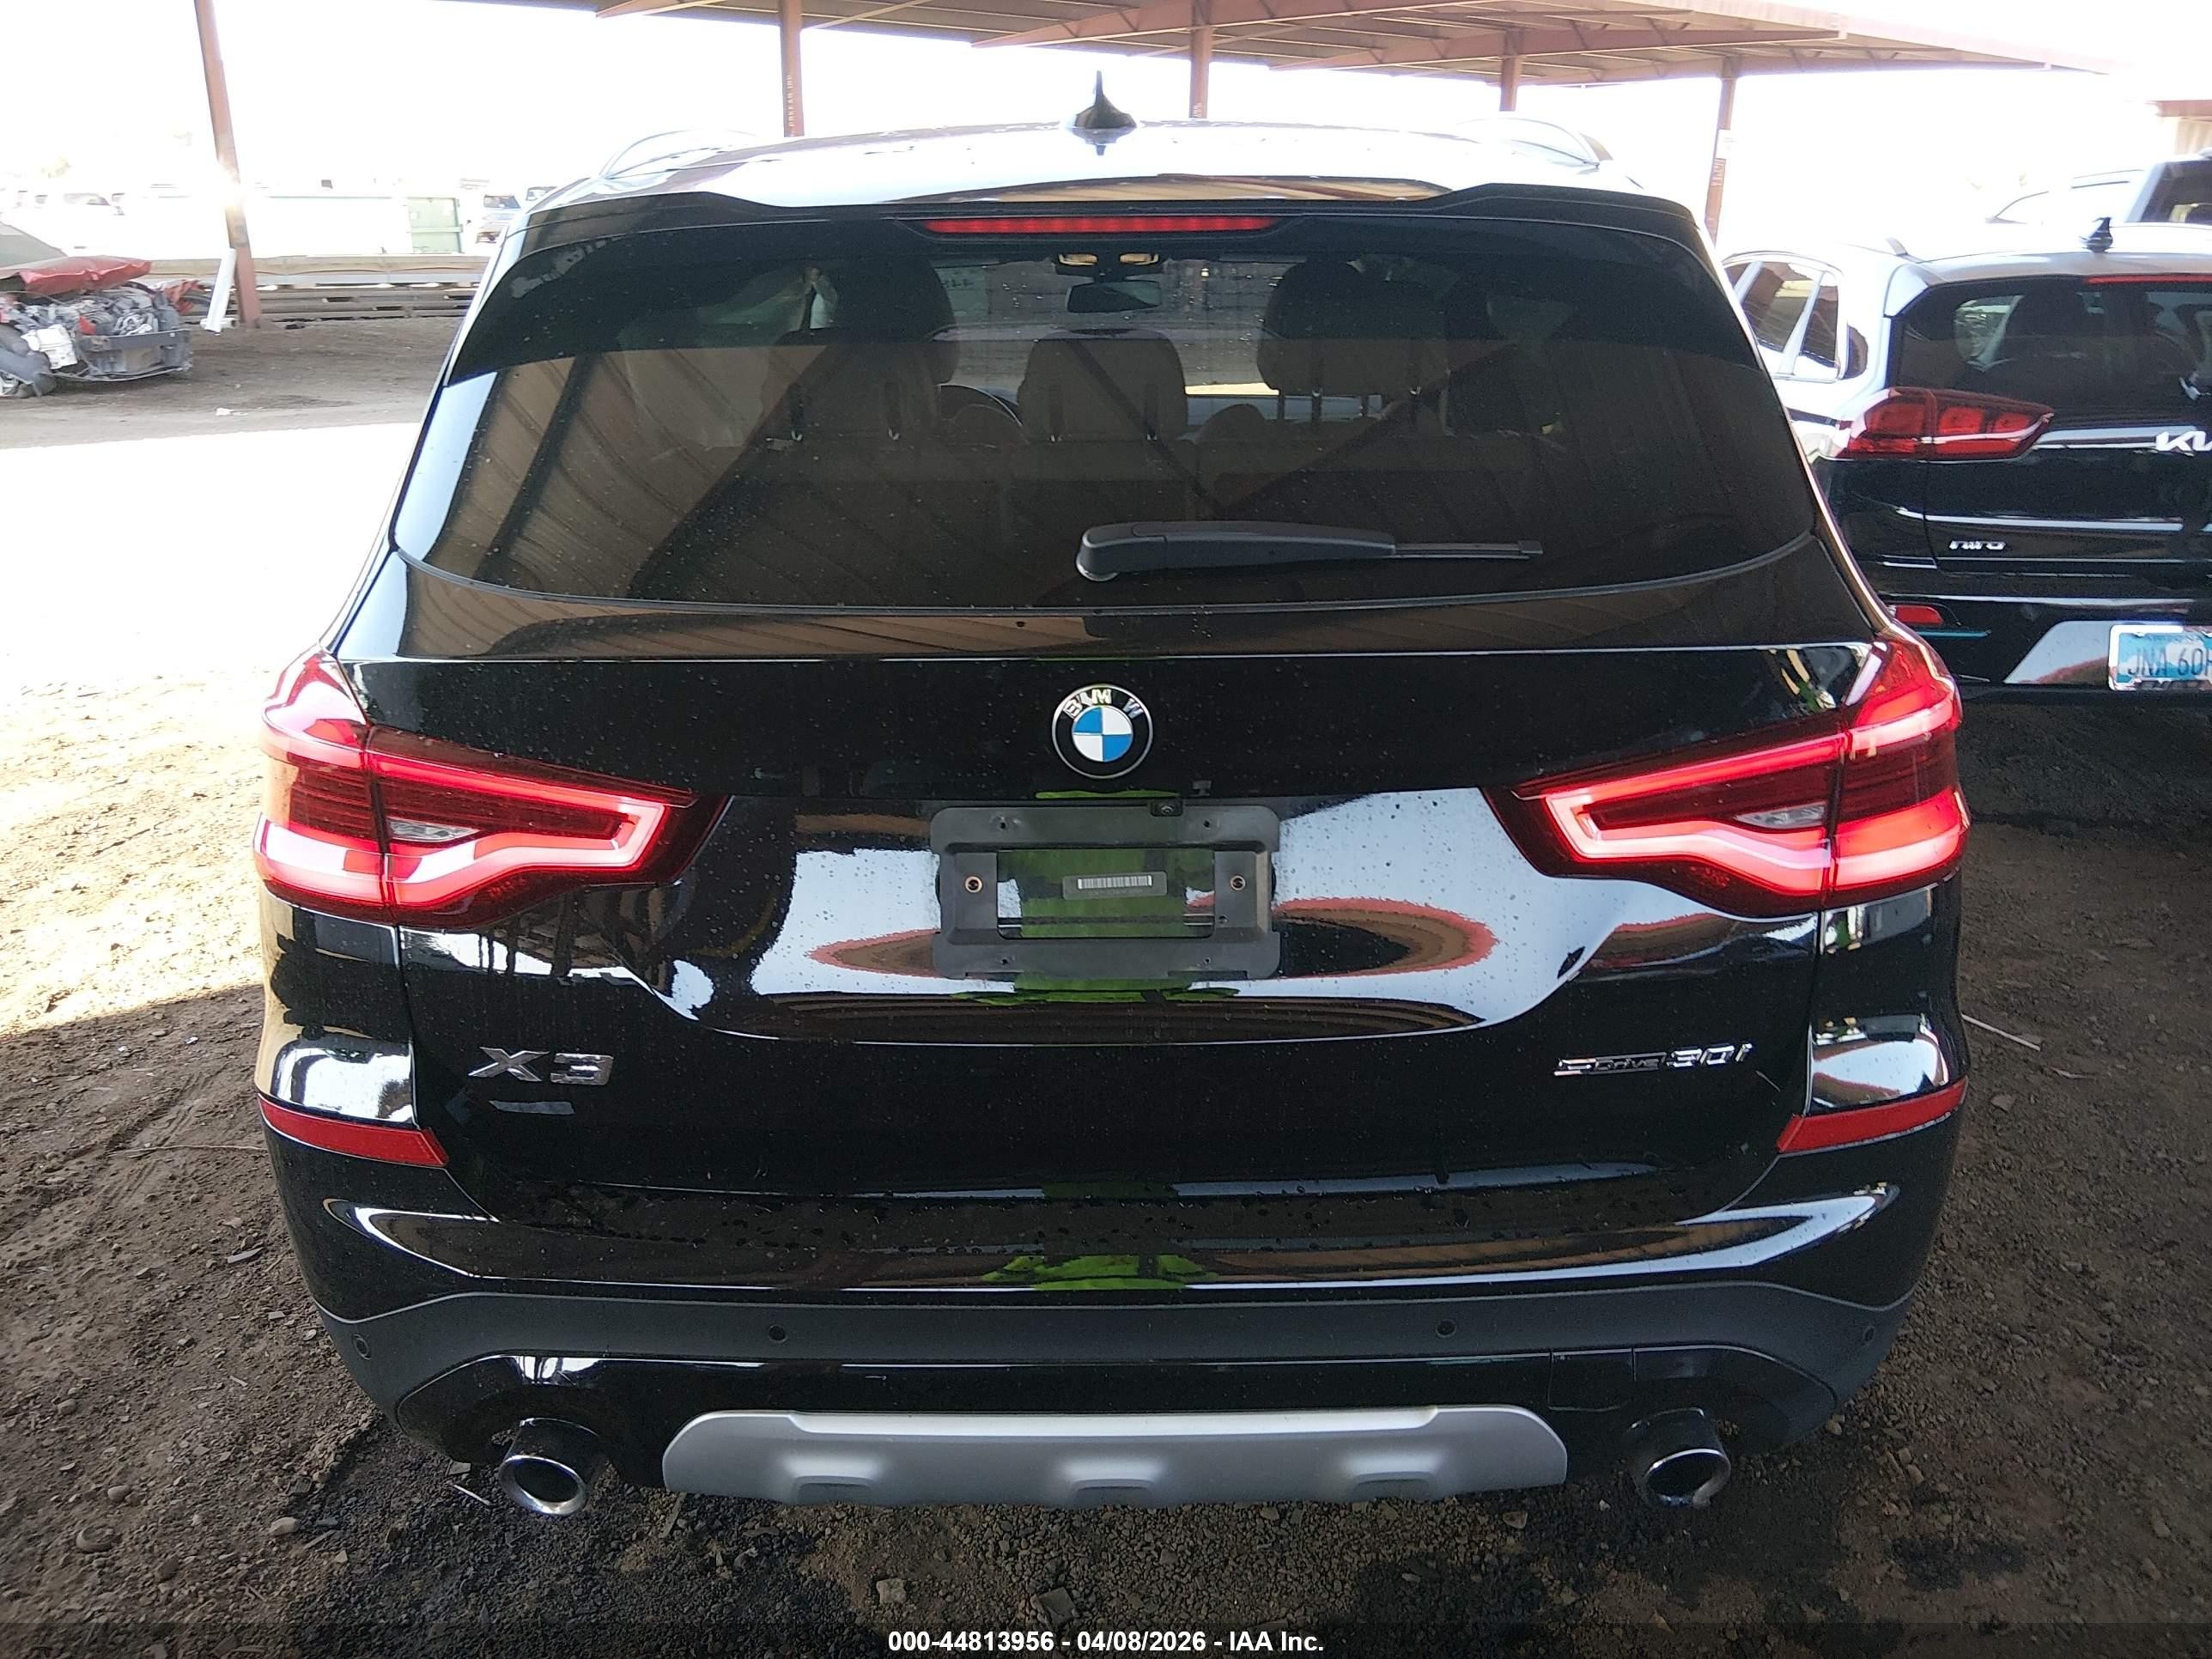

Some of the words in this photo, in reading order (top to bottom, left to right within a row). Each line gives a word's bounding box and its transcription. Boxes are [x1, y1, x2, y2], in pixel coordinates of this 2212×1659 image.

[2128, 647, 2167, 676] JNA
[1062, 688, 1144, 720] BMW
[467, 1046, 615, 1086] X3
